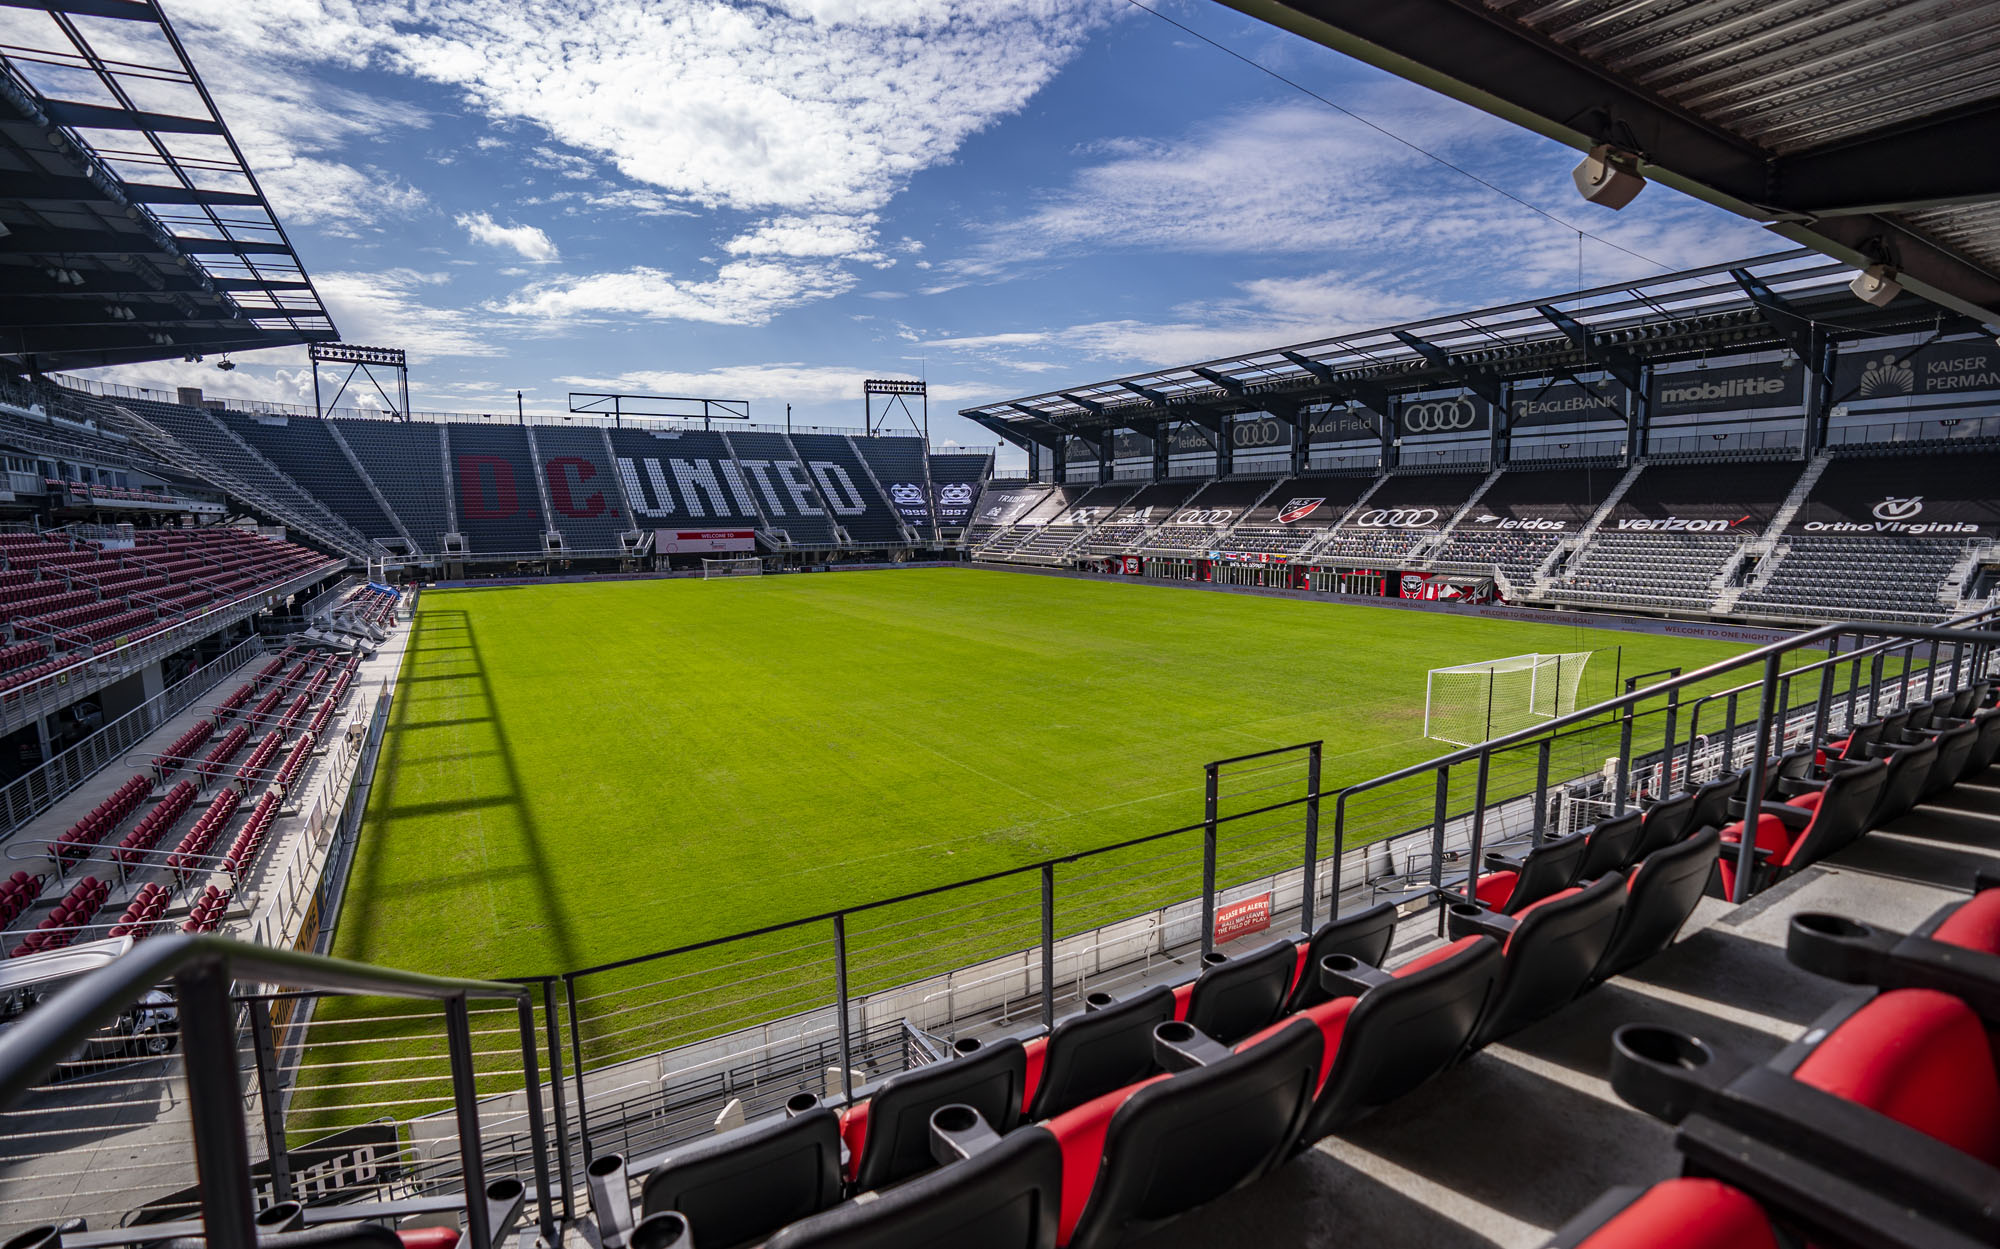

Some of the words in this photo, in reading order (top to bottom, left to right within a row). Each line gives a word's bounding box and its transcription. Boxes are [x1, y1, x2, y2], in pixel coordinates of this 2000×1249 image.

[1928, 356, 1987, 374] KAISER
[1661, 377, 1784, 403] mobilitie
[1307, 420, 1337, 434] Audi
[1340, 417, 1372, 431] Field
[1178, 434, 1208, 449] leidos
[616, 457, 867, 518] UNITED
[1495, 517, 1567, 531] leidos
[1618, 516, 1731, 532] verizon
[1803, 521, 1980, 534] OrthoVirginia
[1480, 609, 1508, 617] WELCOME
[1535, 614, 1555, 622] NIGHT
[1664, 626, 1705, 635] WELCOME
[1720, 631, 1739, 639] ONE
[1741, 632, 1769, 641] NIGHT
[1218, 909, 1238, 922] PLEASE
[1239, 906, 1247, 914] BE
[1247, 901, 1269, 912] ALERT!
[1246, 911, 1265, 919] LEAVE
[1217, 926, 1228, 935] THE
[1228, 922, 1244, 931] FIELD
